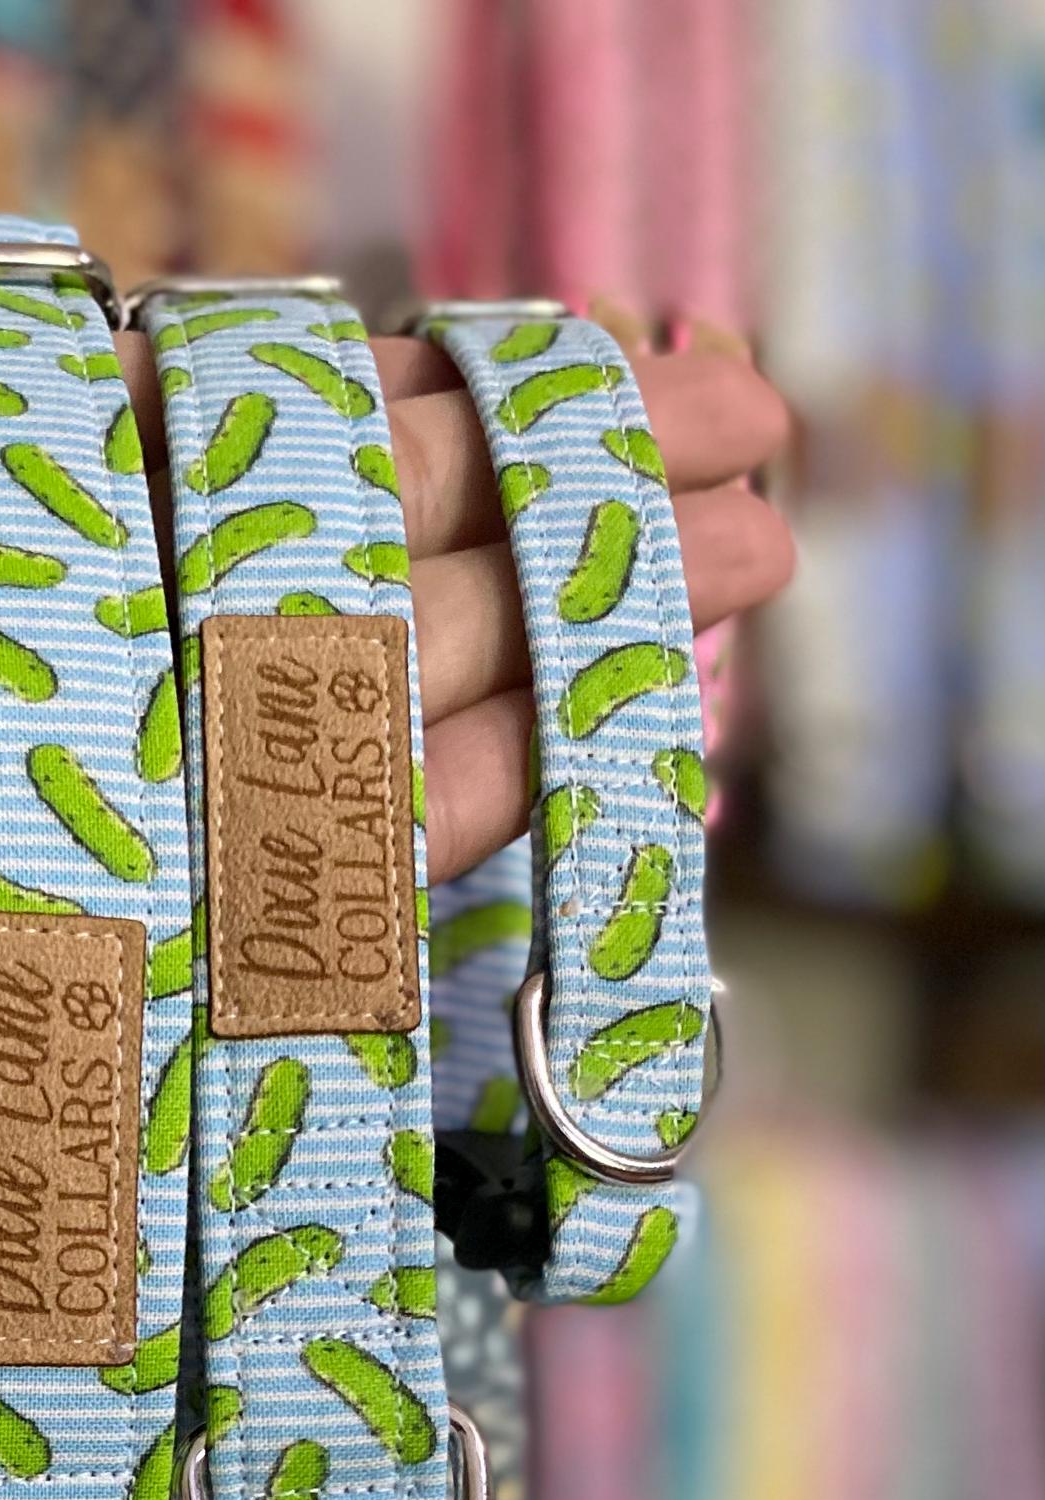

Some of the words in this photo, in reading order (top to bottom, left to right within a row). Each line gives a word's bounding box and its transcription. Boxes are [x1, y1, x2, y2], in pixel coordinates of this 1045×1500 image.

[236, 656, 326, 798] Lane
[237, 825, 332, 980] Dixie
[331, 736, 390, 983] COLLARS
[56, 1058, 113, 1317] COLLARS
